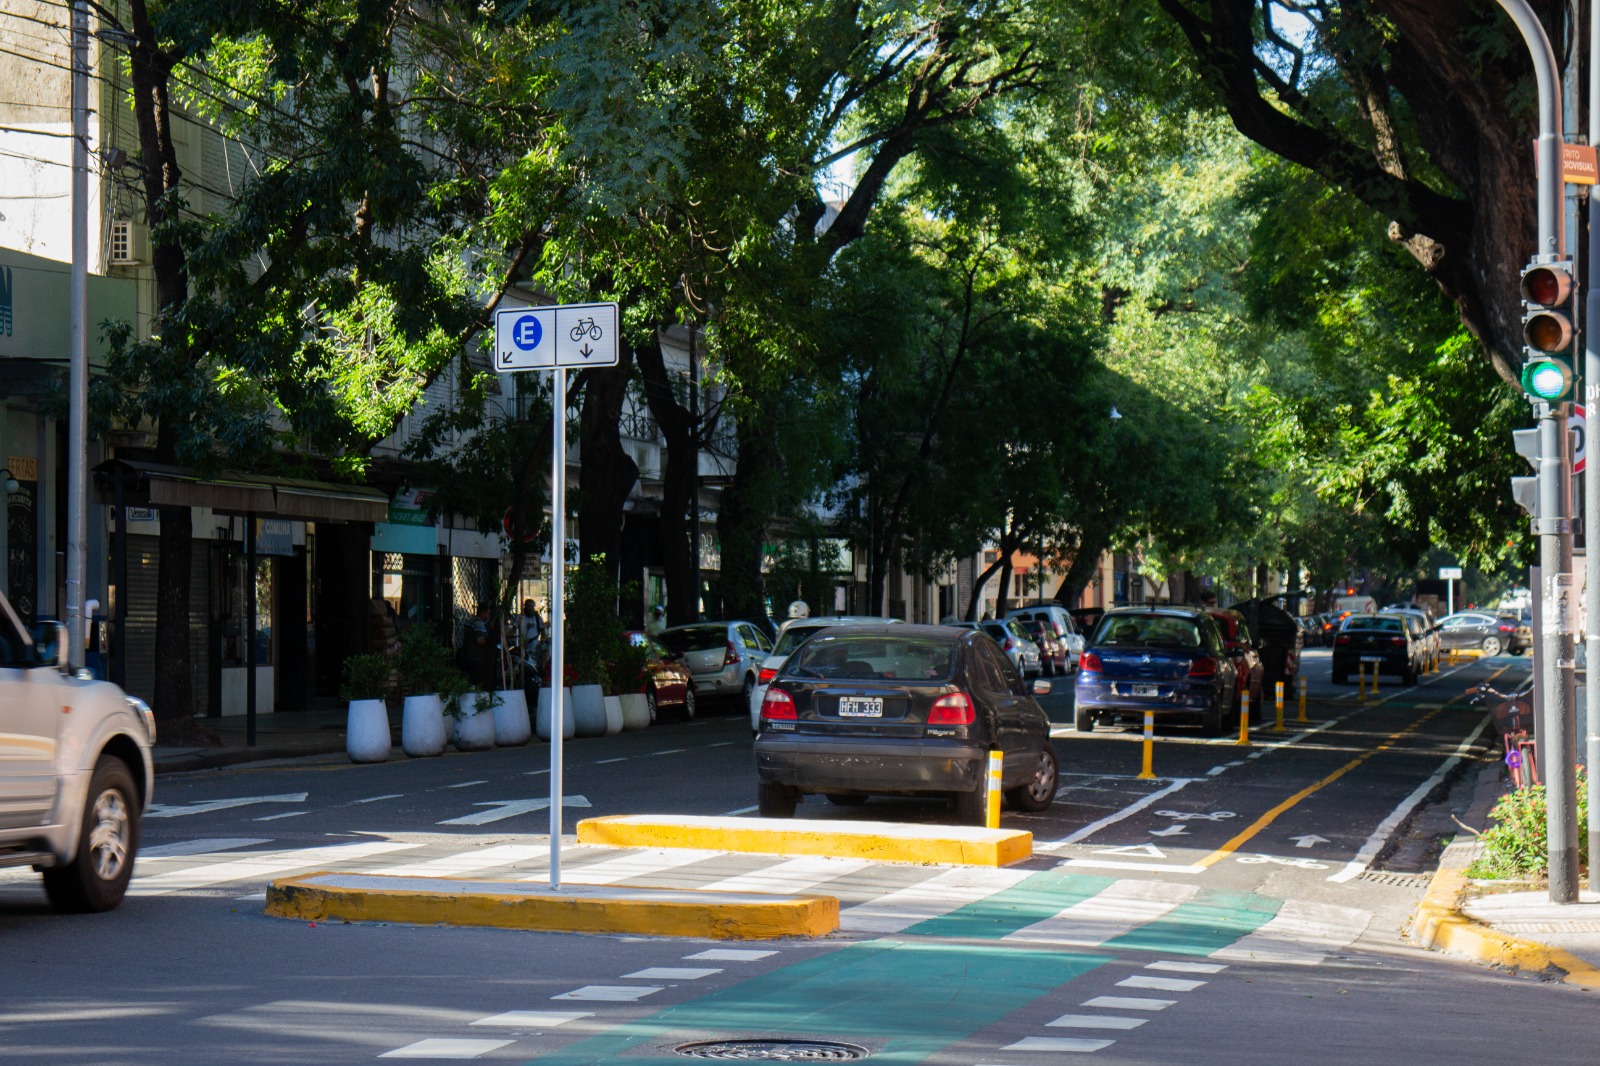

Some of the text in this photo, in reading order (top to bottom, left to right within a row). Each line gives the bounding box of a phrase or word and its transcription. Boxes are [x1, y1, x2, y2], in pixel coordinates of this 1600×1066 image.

[520, 321, 534, 345] E
[265, 521, 291, 537] COMUNA
[841, 702, 881, 713] HFH 333
